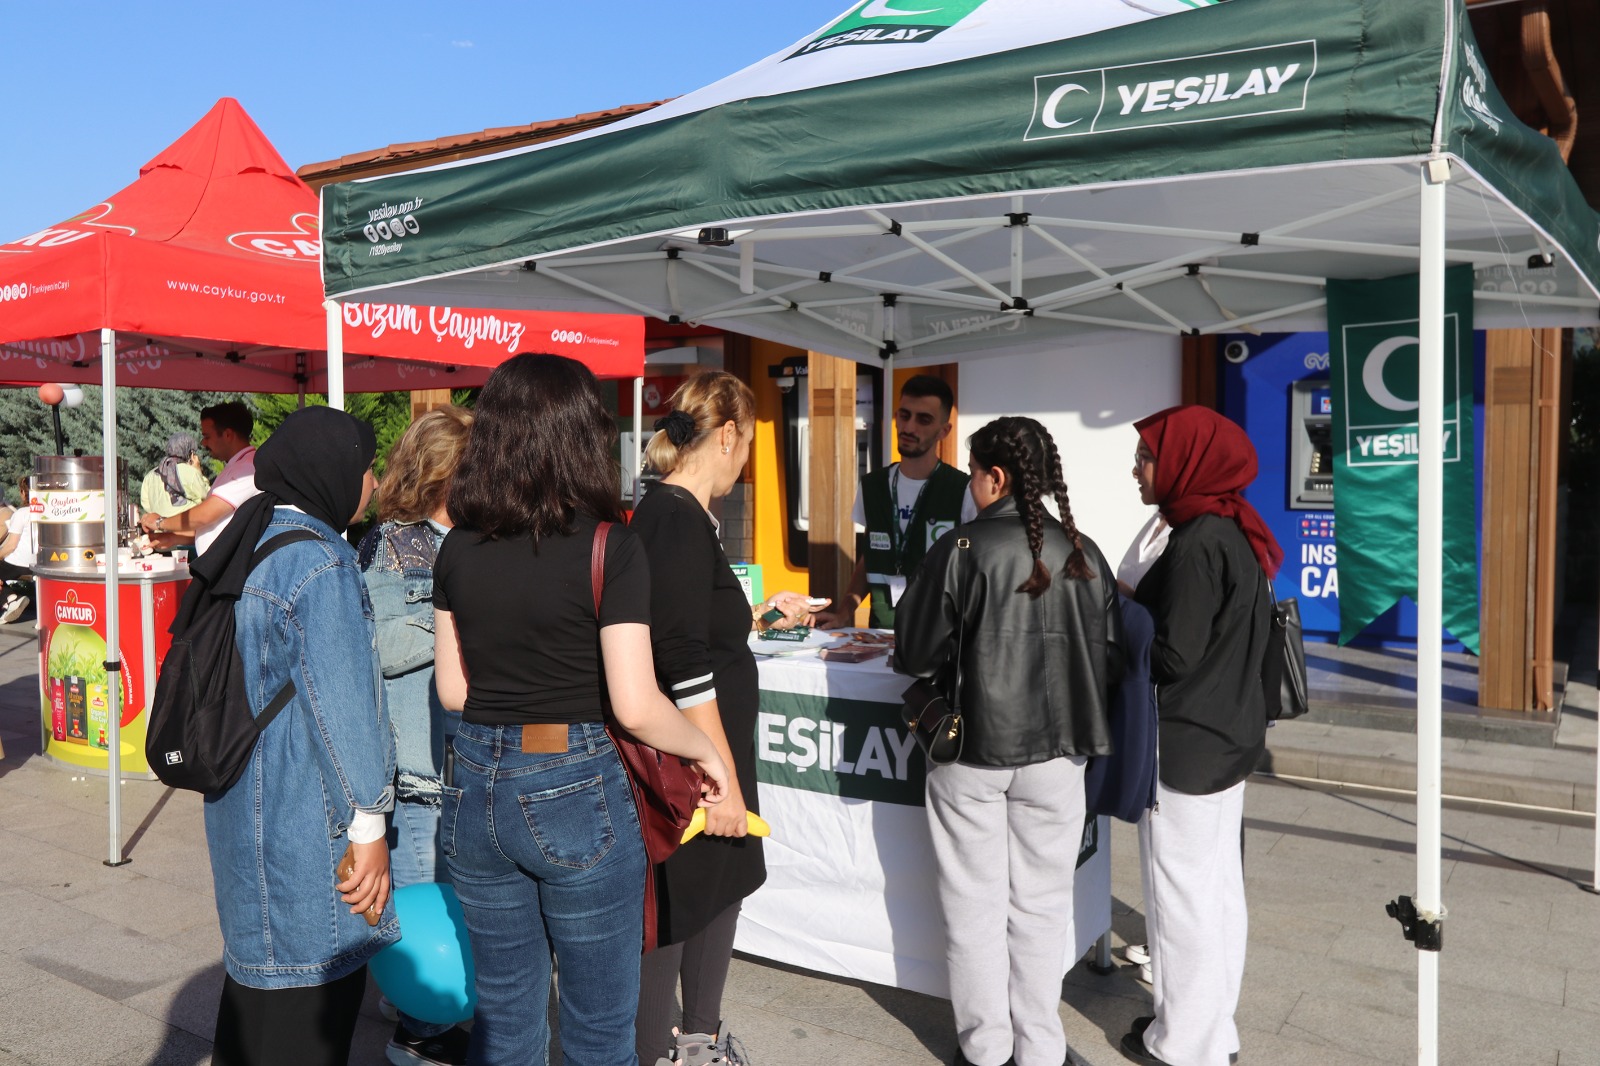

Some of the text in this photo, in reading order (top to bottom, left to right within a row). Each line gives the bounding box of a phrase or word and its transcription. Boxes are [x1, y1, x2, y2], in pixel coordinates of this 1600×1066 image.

[167, 279, 286, 304] www.caykur.gov.tr
[1301, 543, 1337, 566] INS
[1301, 565, 1339, 599] CA
[57, 605, 93, 621] ÇAYKUR
